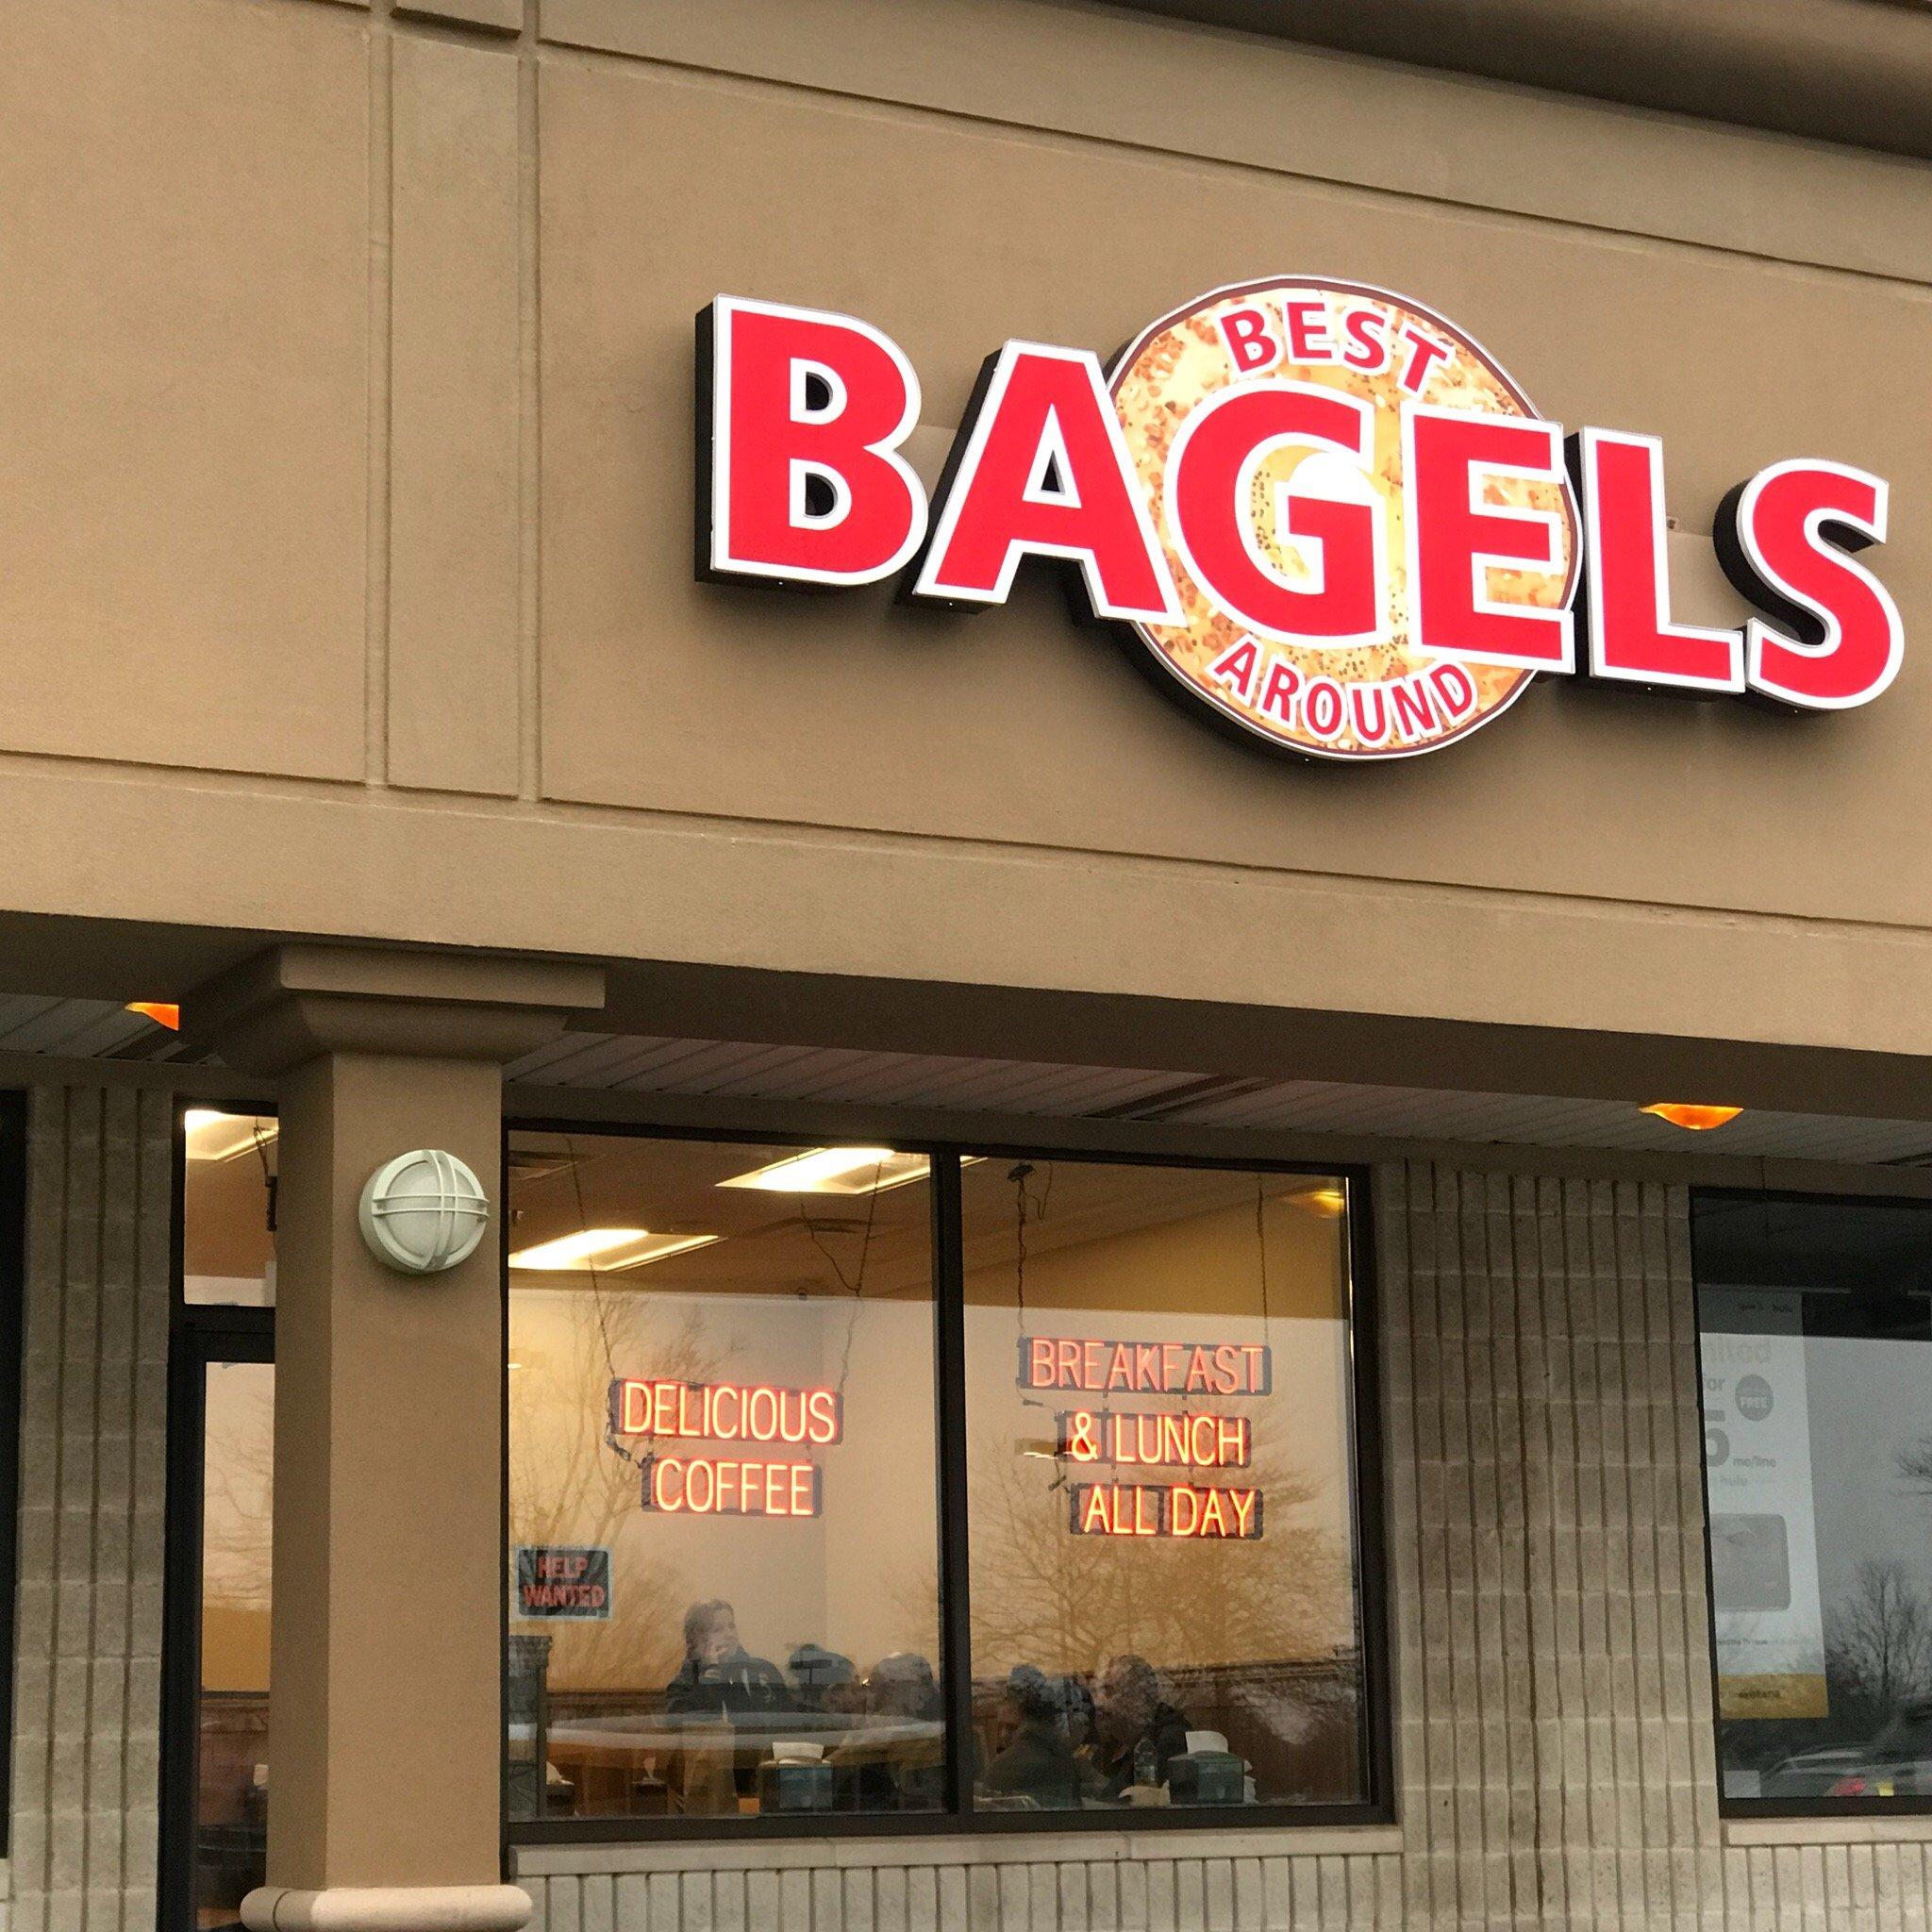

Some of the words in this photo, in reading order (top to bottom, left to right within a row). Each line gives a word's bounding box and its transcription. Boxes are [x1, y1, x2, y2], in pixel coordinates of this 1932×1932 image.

[1216, 298, 1452, 396] BEST
[710, 294, 1904, 713] BAGELS
[1208, 637, 1478, 745] AROUND
[1030, 1338, 1264, 1395] BREAKFAST
[621, 1380, 837, 1444] DELICIOUS
[1070, 1411, 1099, 1462] &
[1113, 1414, 1245, 1467] LUNCH
[654, 1457, 815, 1517] COFFEE
[1083, 1484, 1158, 1537] ALL
[1170, 1485, 1256, 1539] DAY
[523, 1584, 606, 1607] WANTED
[537, 1557, 589, 1579] HELP
